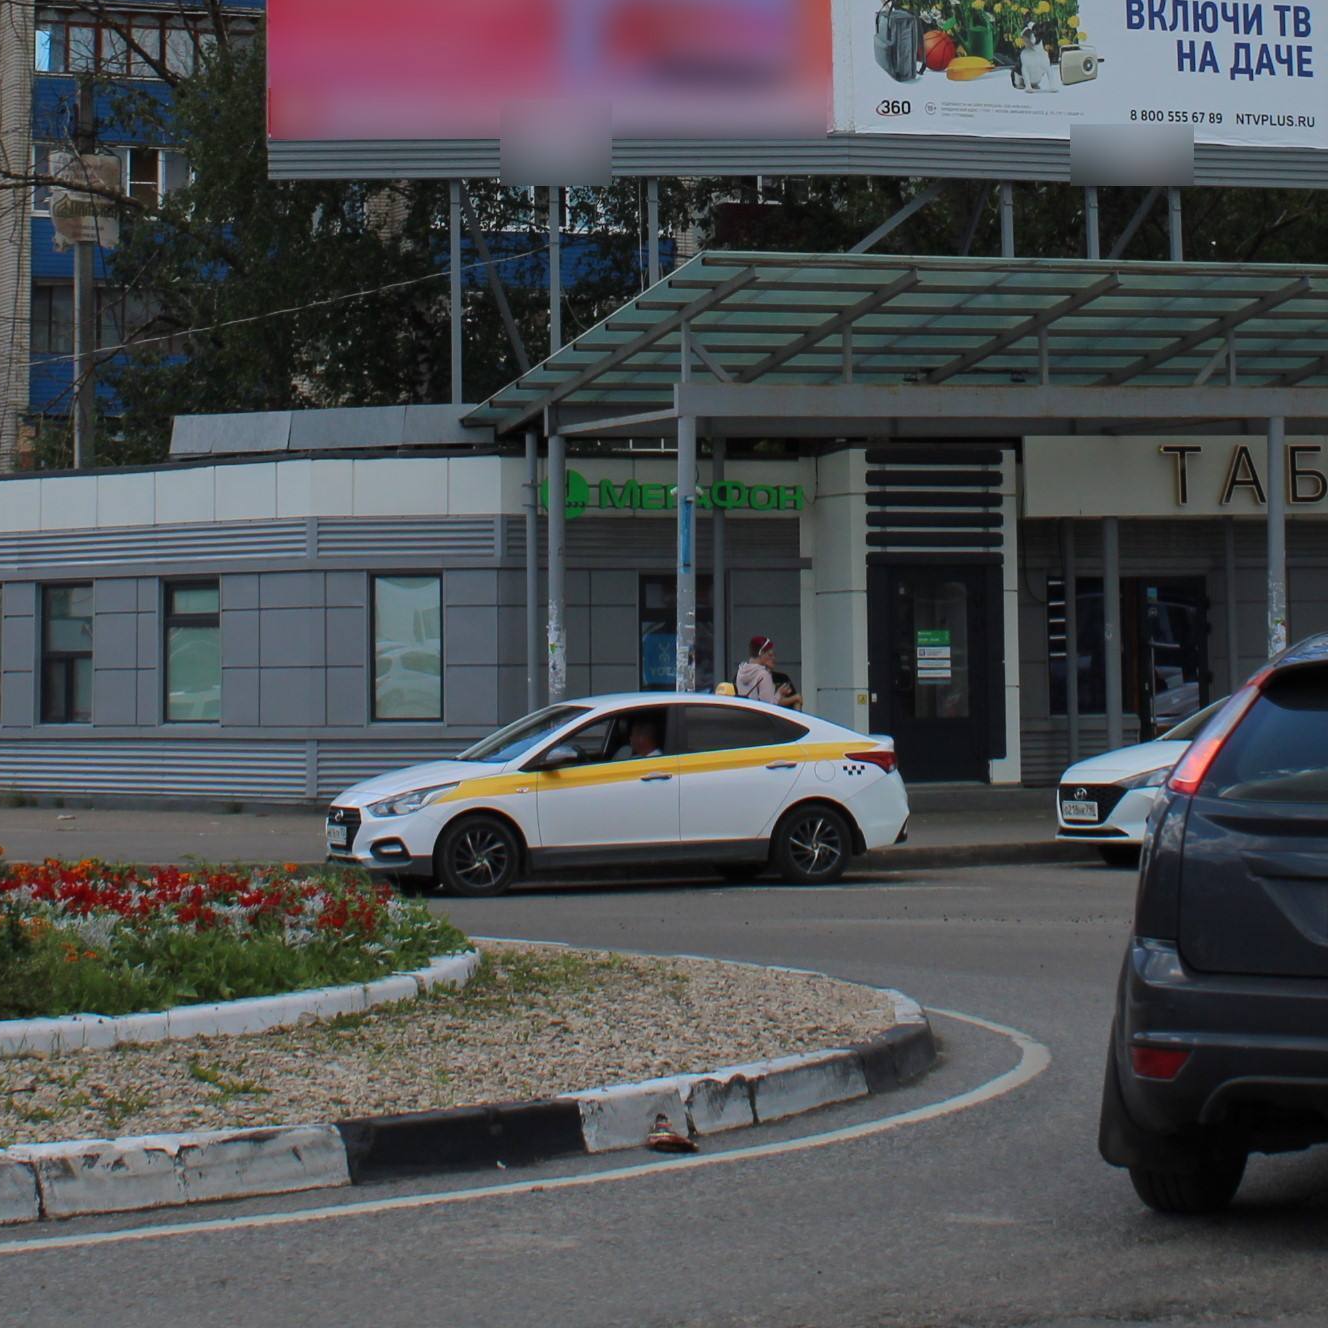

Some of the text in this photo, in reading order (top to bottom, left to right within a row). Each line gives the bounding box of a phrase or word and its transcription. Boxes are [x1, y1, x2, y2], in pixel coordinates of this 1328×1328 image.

[1273, 4, 1312, 38] ТВ
[1176, 39, 1314, 81] НА ДАЧЕ
[880, 100, 911, 115] 360
[1130, 109, 1316, 128] 8 800 555 67 89 NTVPLUS.RU
